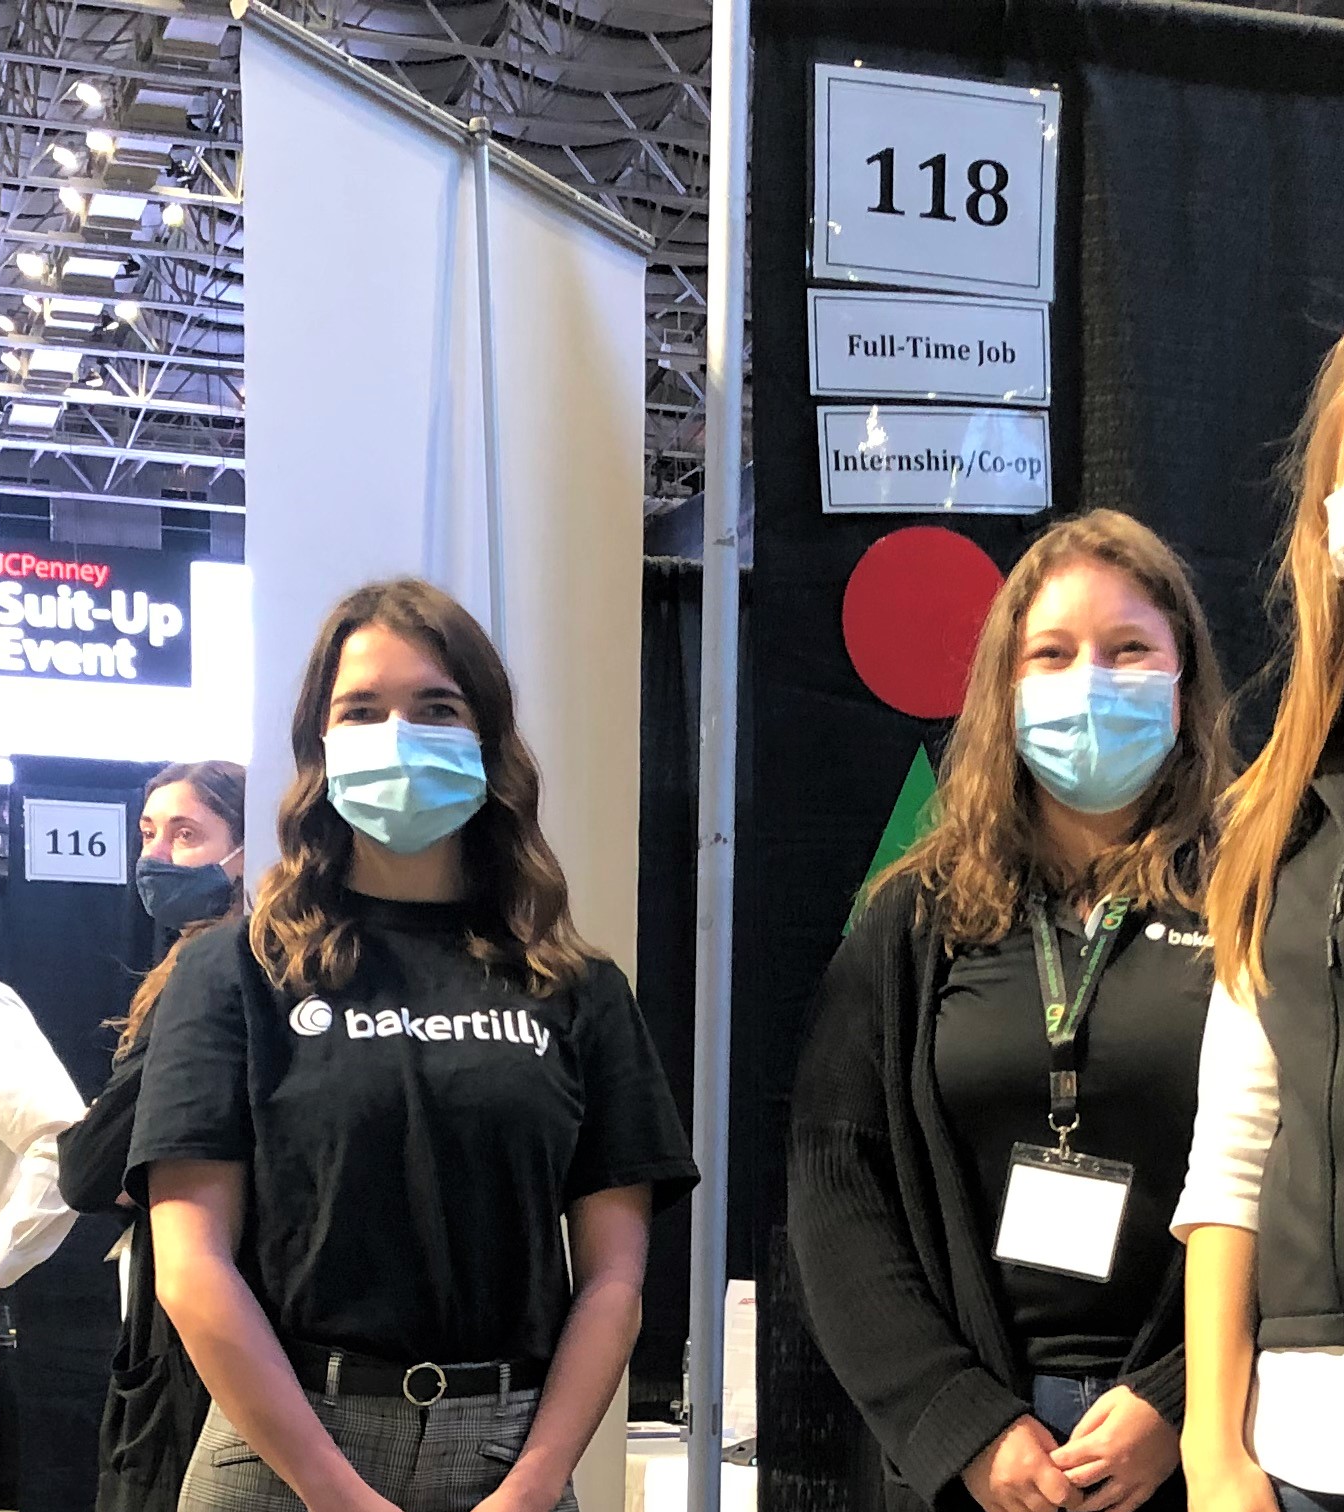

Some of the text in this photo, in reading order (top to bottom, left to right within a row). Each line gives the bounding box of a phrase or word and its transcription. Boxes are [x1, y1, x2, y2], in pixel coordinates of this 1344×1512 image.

[866, 147, 1009, 227] 118
[848, 334, 1016, 366] Full-Time Job
[833, 448, 1042, 480] Internship/Co-op
[46, 829, 107, 857] 116
[344, 1008, 550, 1056] bakertilly
